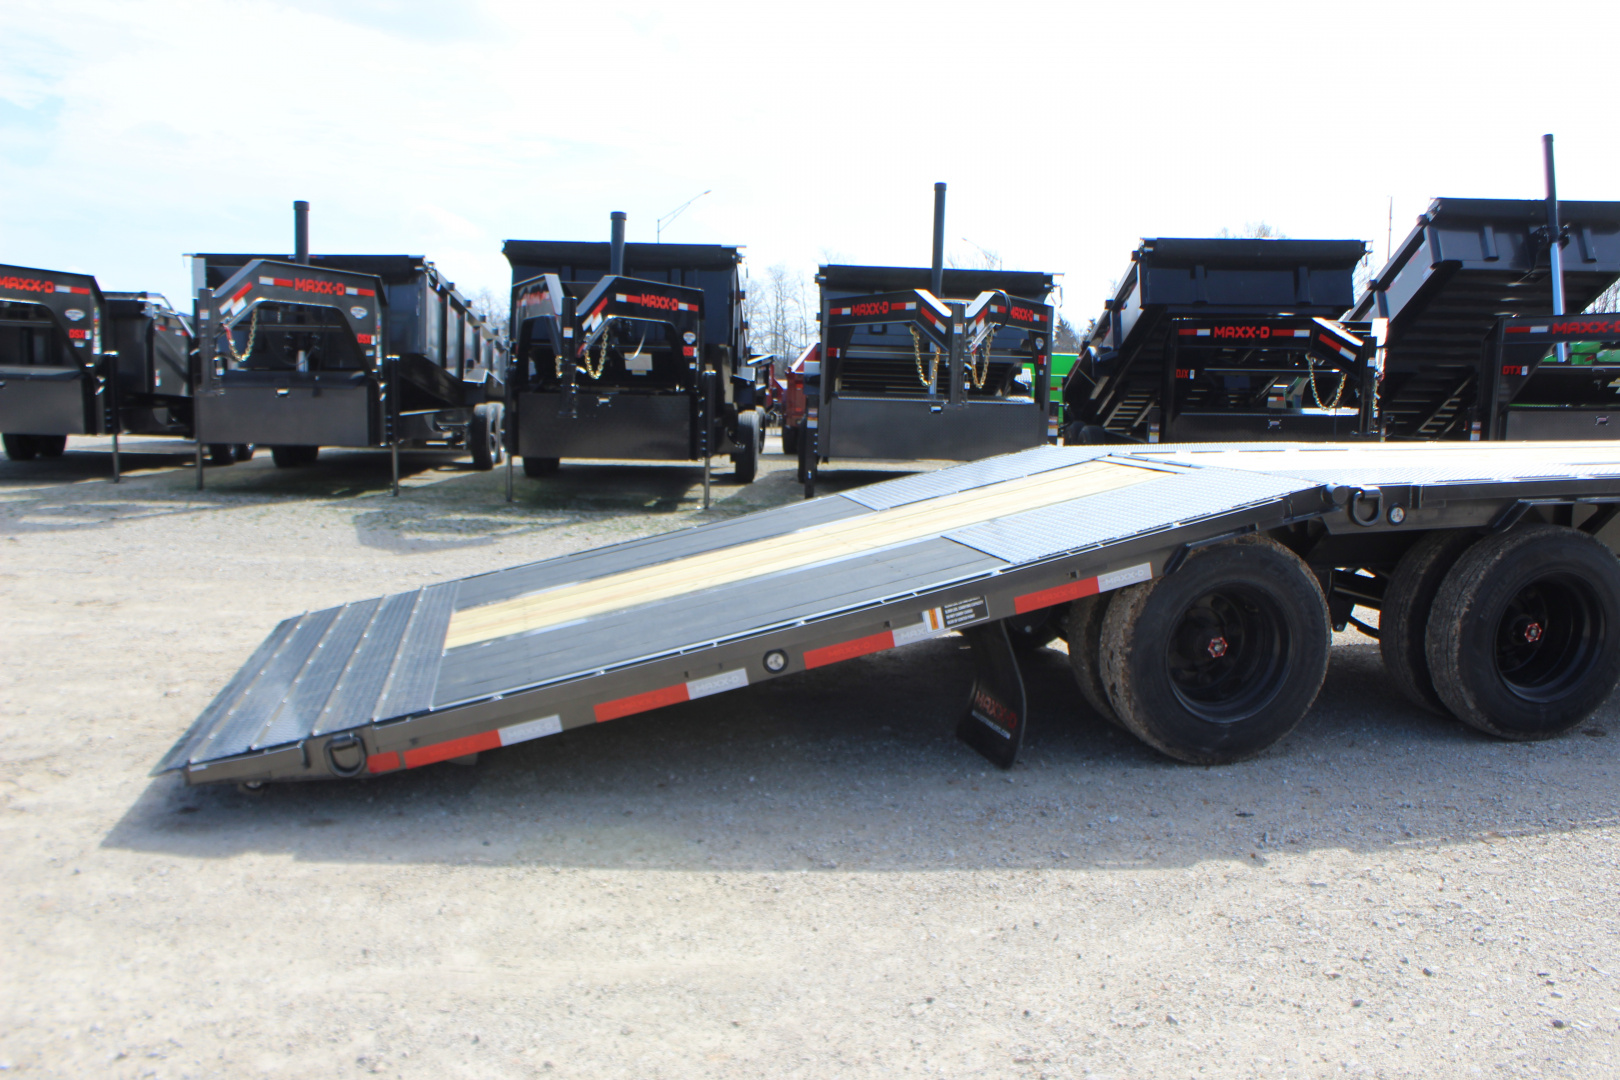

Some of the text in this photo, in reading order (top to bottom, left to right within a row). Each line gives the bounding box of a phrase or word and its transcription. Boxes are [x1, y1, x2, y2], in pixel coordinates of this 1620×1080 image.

[294, 278, 345, 296] MAXX-D
[641, 293, 678, 311] MAXX-D
[851, 301, 889, 316] MAXX-D
[1213, 326, 1270, 338] MAXX-D
[1502, 365, 1522, 375] DTX
